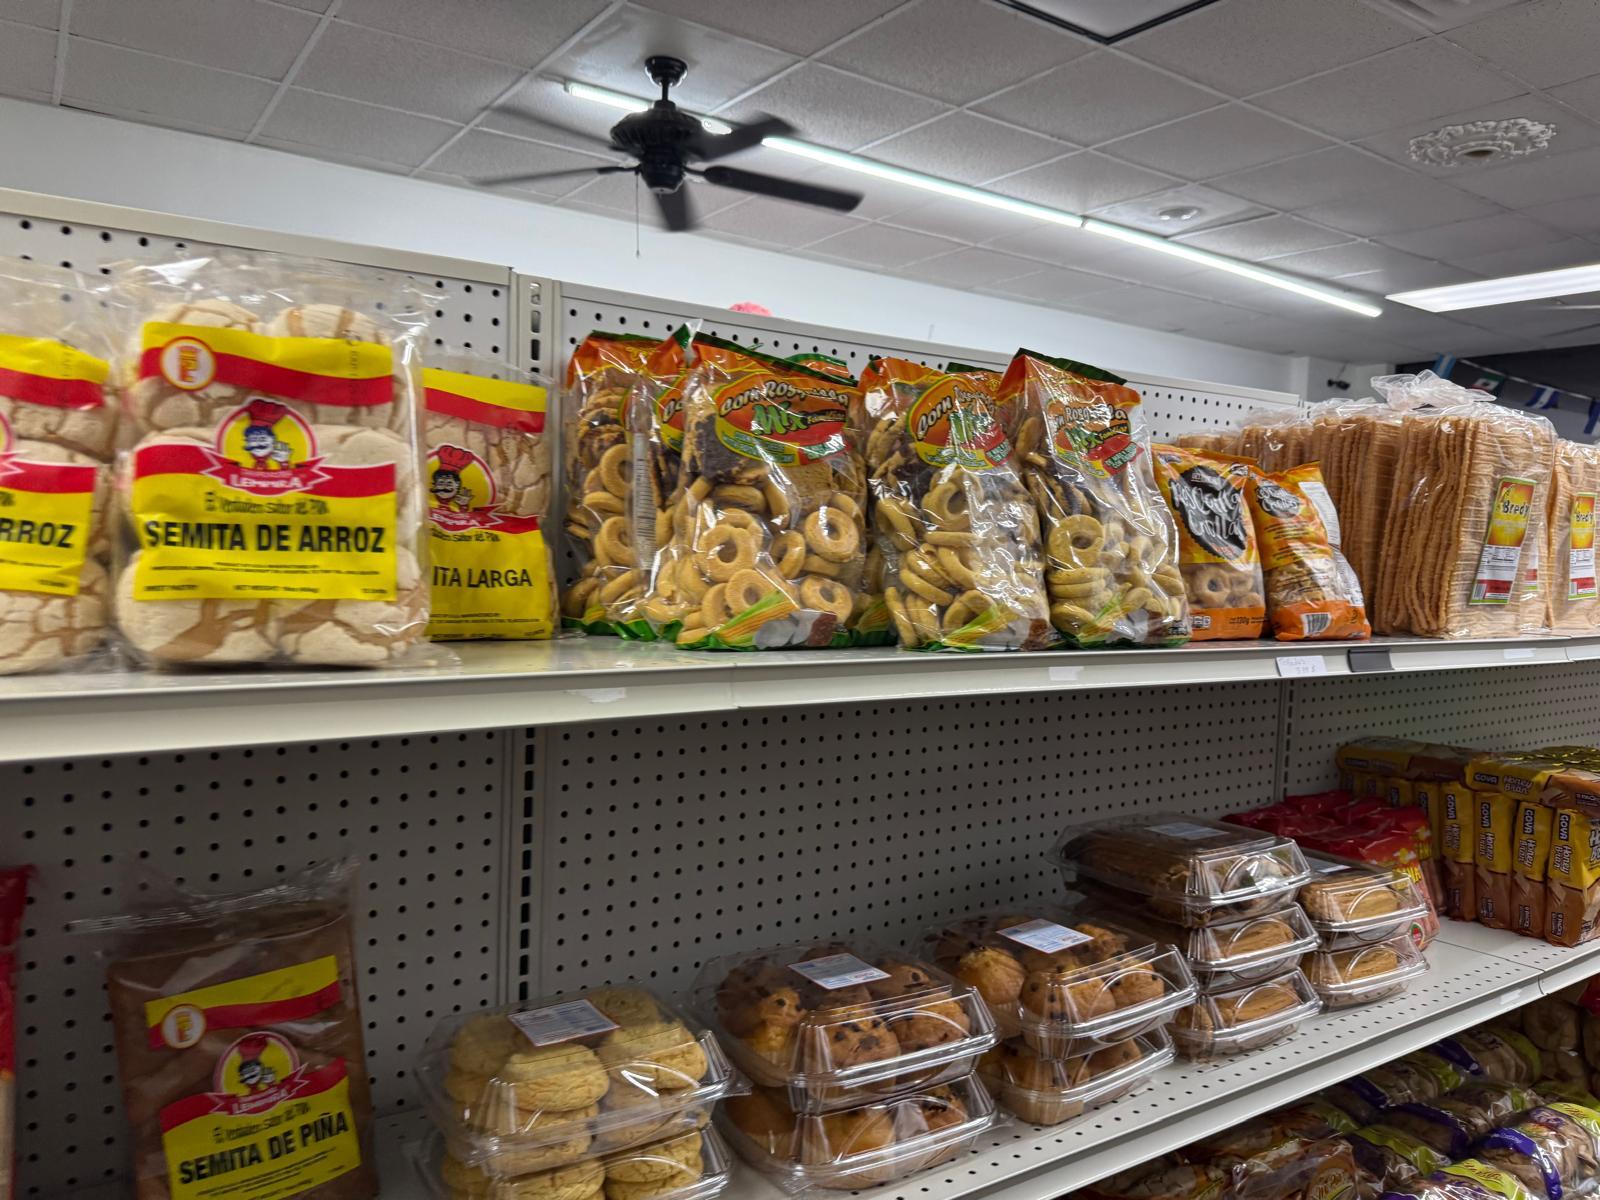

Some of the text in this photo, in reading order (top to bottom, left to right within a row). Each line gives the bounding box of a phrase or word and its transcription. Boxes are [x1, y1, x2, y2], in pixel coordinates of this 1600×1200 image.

[751, 401, 809, 436] Mix
[144, 520, 386, 553] SEMITA DE ARROZ
[467, 567, 534, 588] LARGA
[1561, 845, 1572, 874] Honey
[179, 1143, 262, 1185] SEMITA
[268, 1131, 297, 1160] DE
[300, 1112, 349, 1148] PIÑA
